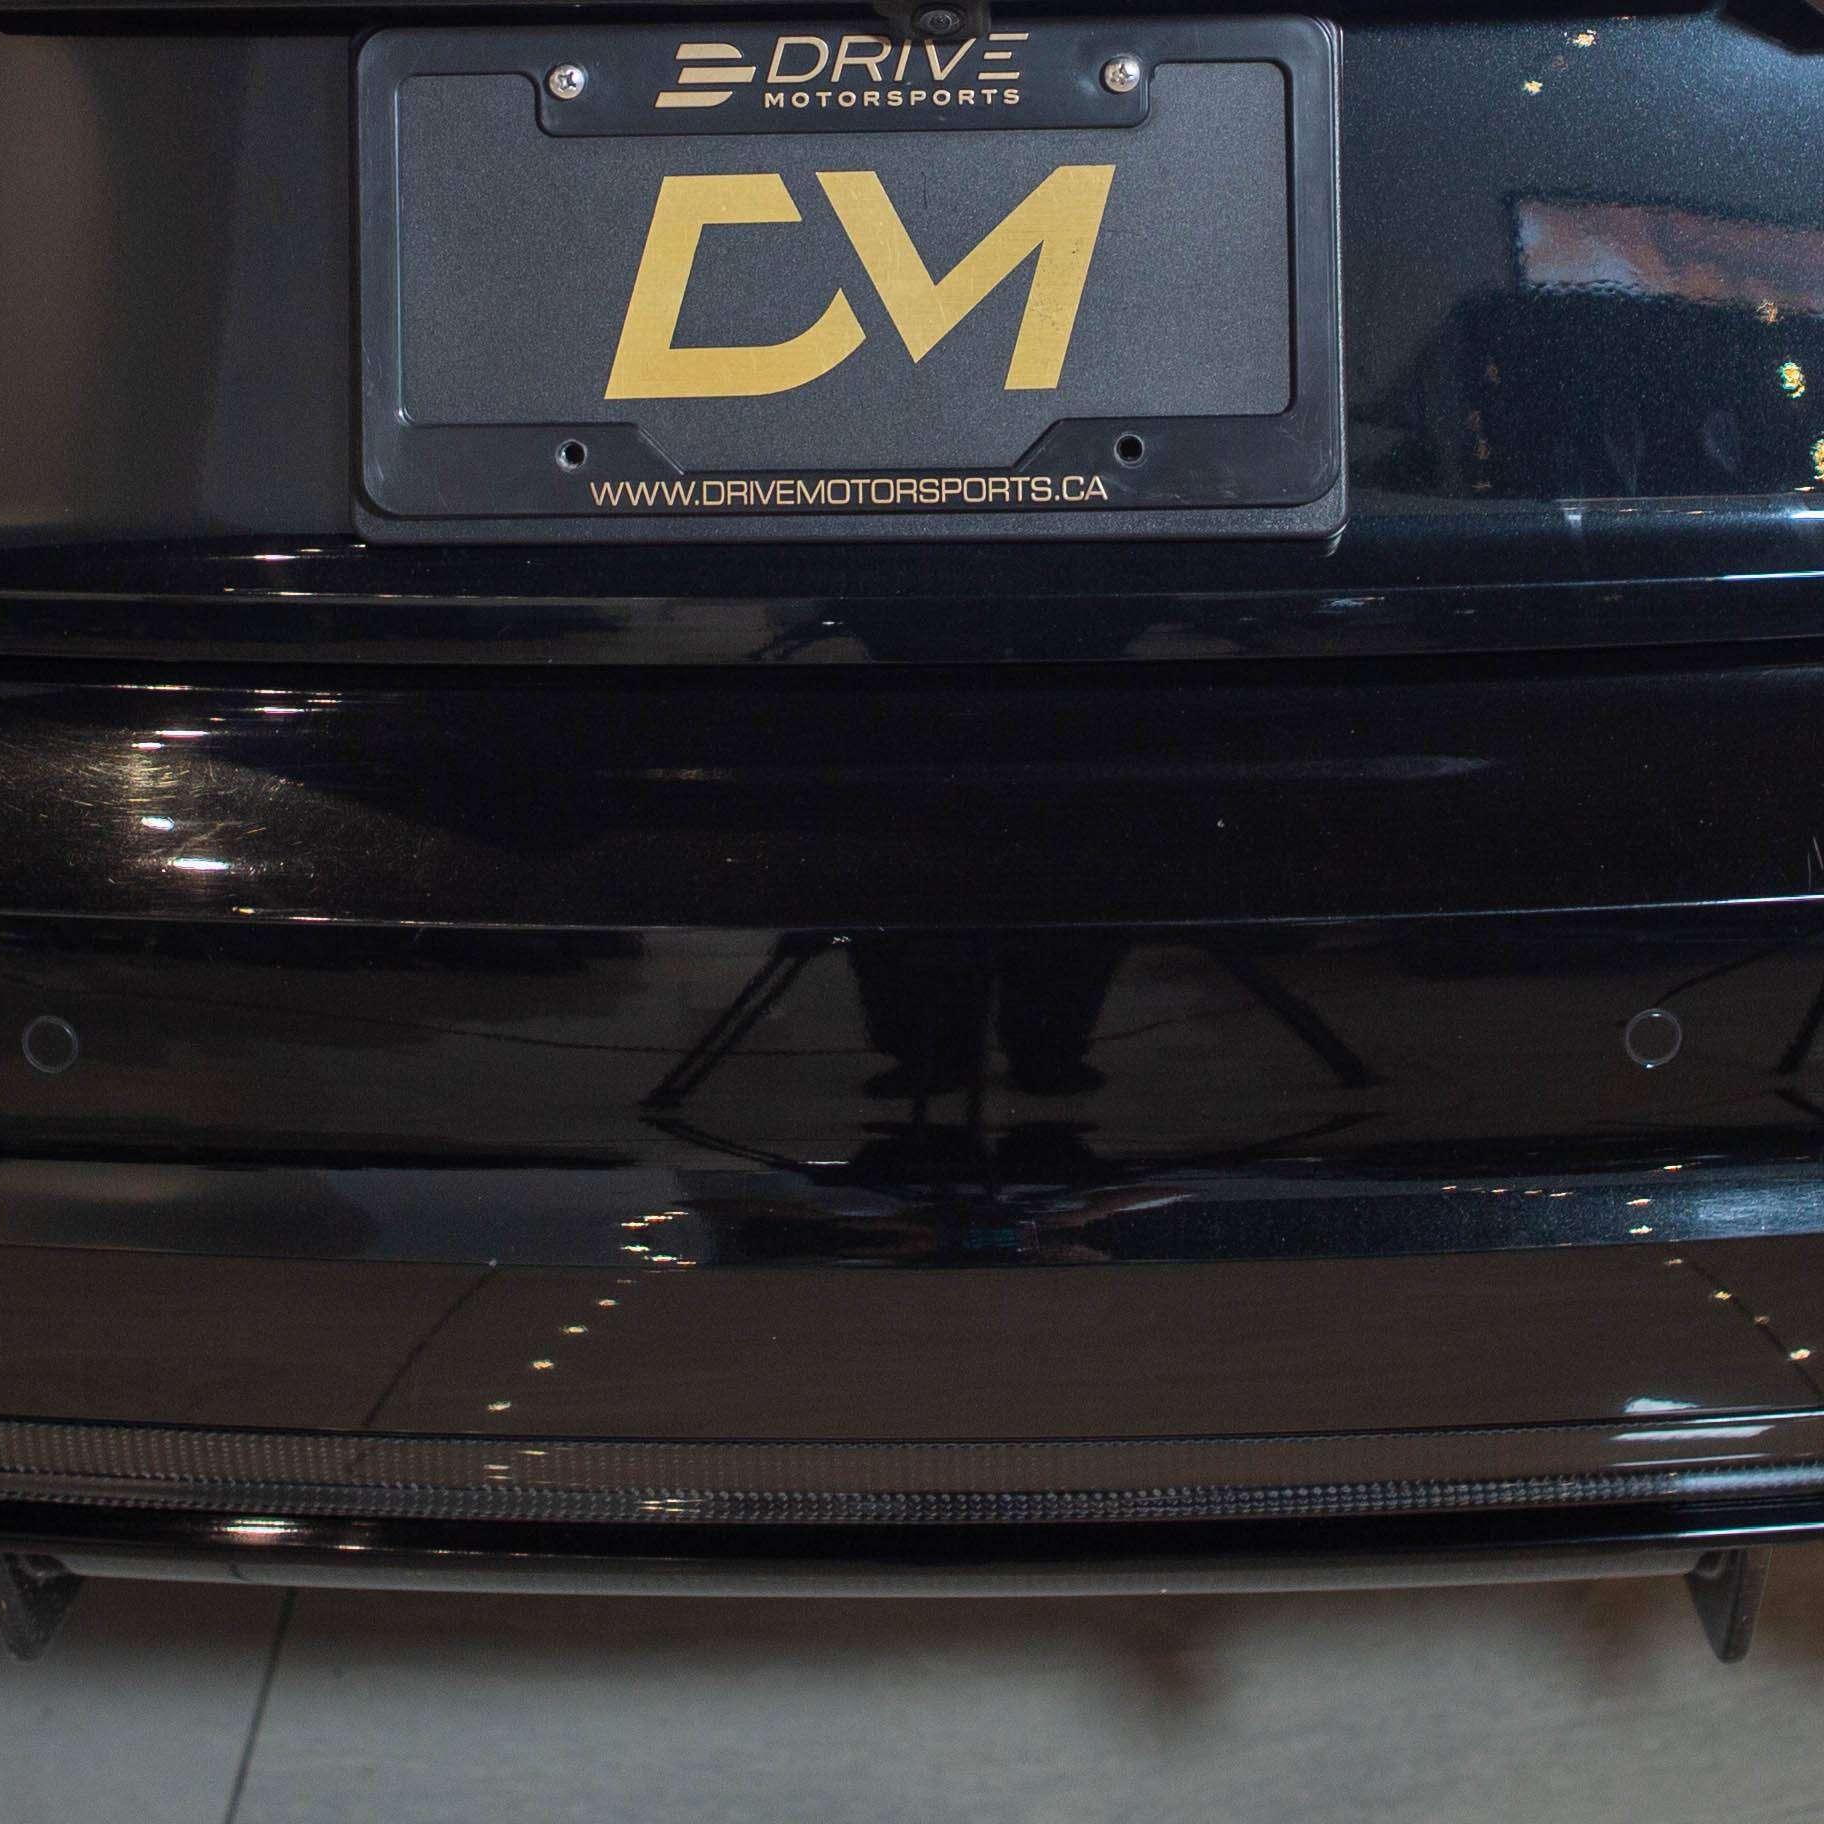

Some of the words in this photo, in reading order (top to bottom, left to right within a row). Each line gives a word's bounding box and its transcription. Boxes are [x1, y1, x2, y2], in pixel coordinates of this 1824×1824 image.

[766, 32, 1030, 83] DRIVE
[764, 88, 1021, 108] MOTORSPORTS
[590, 475, 1109, 507] WWW.DRIVEMOTORSPORTS.CA
